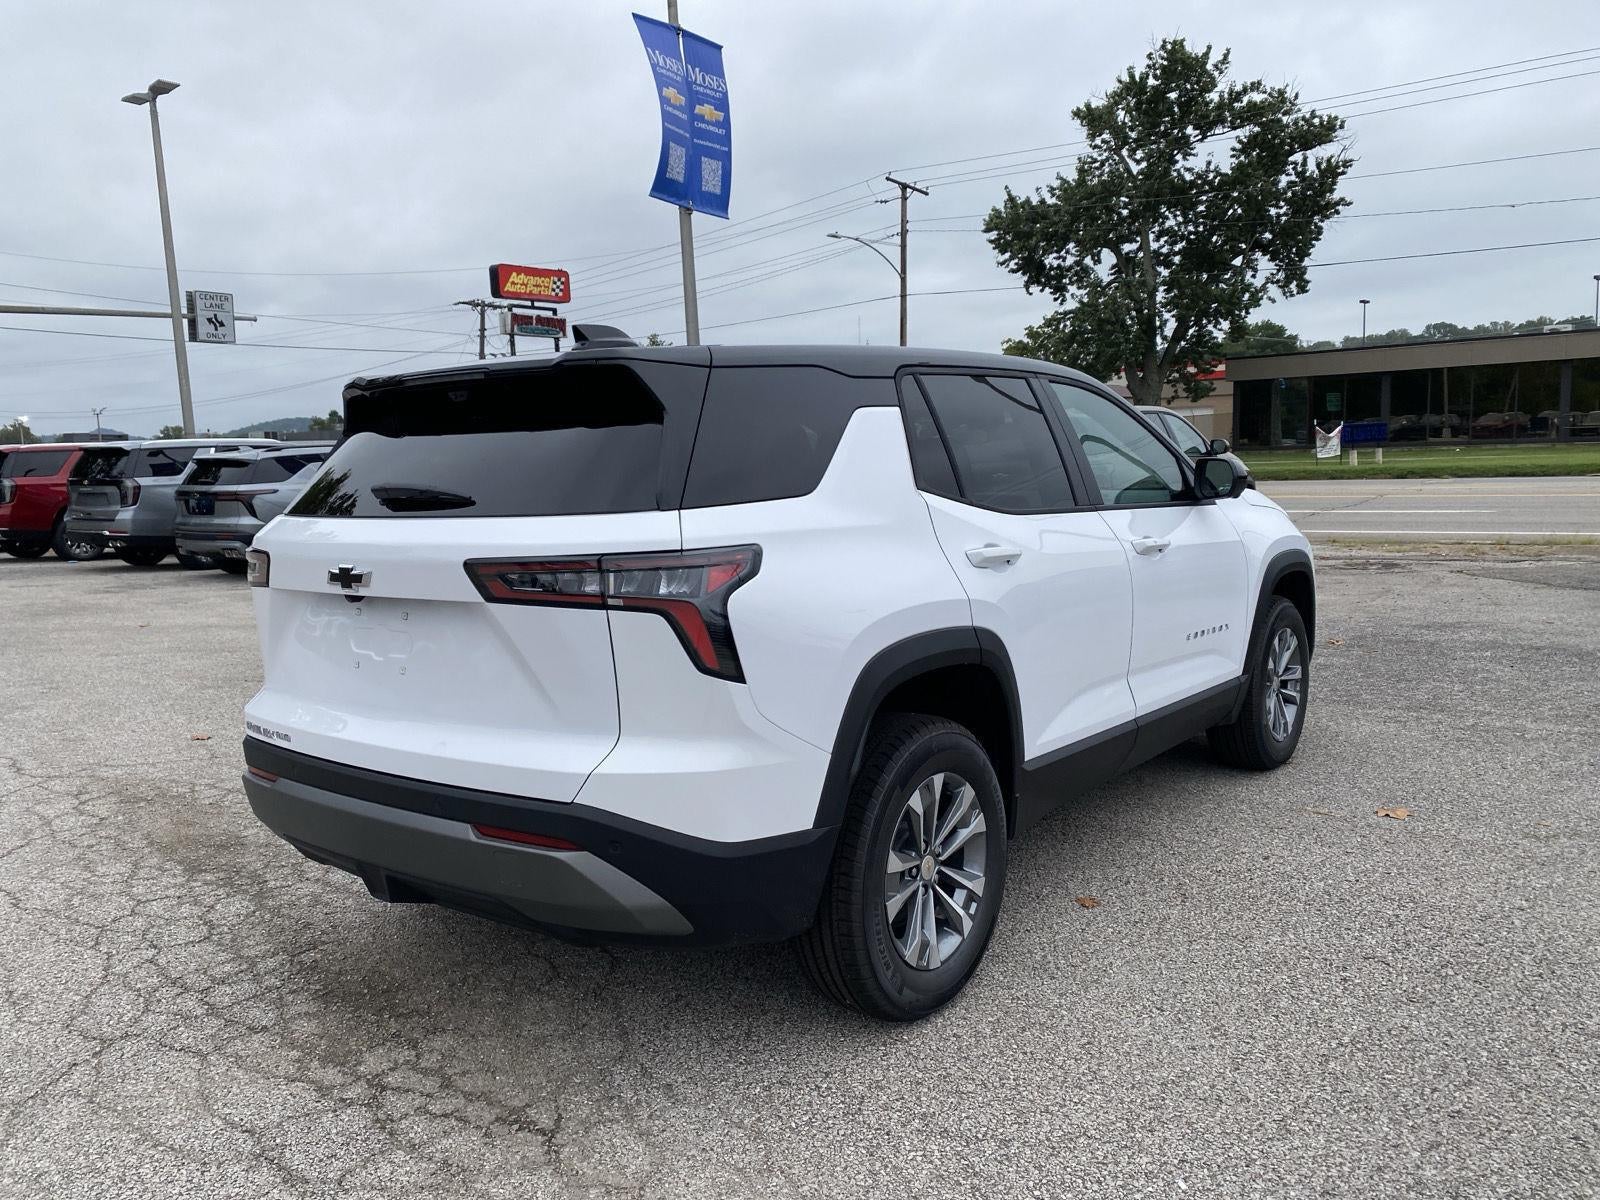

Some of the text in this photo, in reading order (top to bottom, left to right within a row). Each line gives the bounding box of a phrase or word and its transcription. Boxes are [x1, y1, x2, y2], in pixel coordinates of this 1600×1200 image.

[693, 85, 722, 98] CHEVROLET
[694, 121, 726, 135] CHEVROLET
[510, 272, 550, 285] Advance
[505, 283, 549, 294] Auto Parts
[199, 294, 229, 302] CENTER
